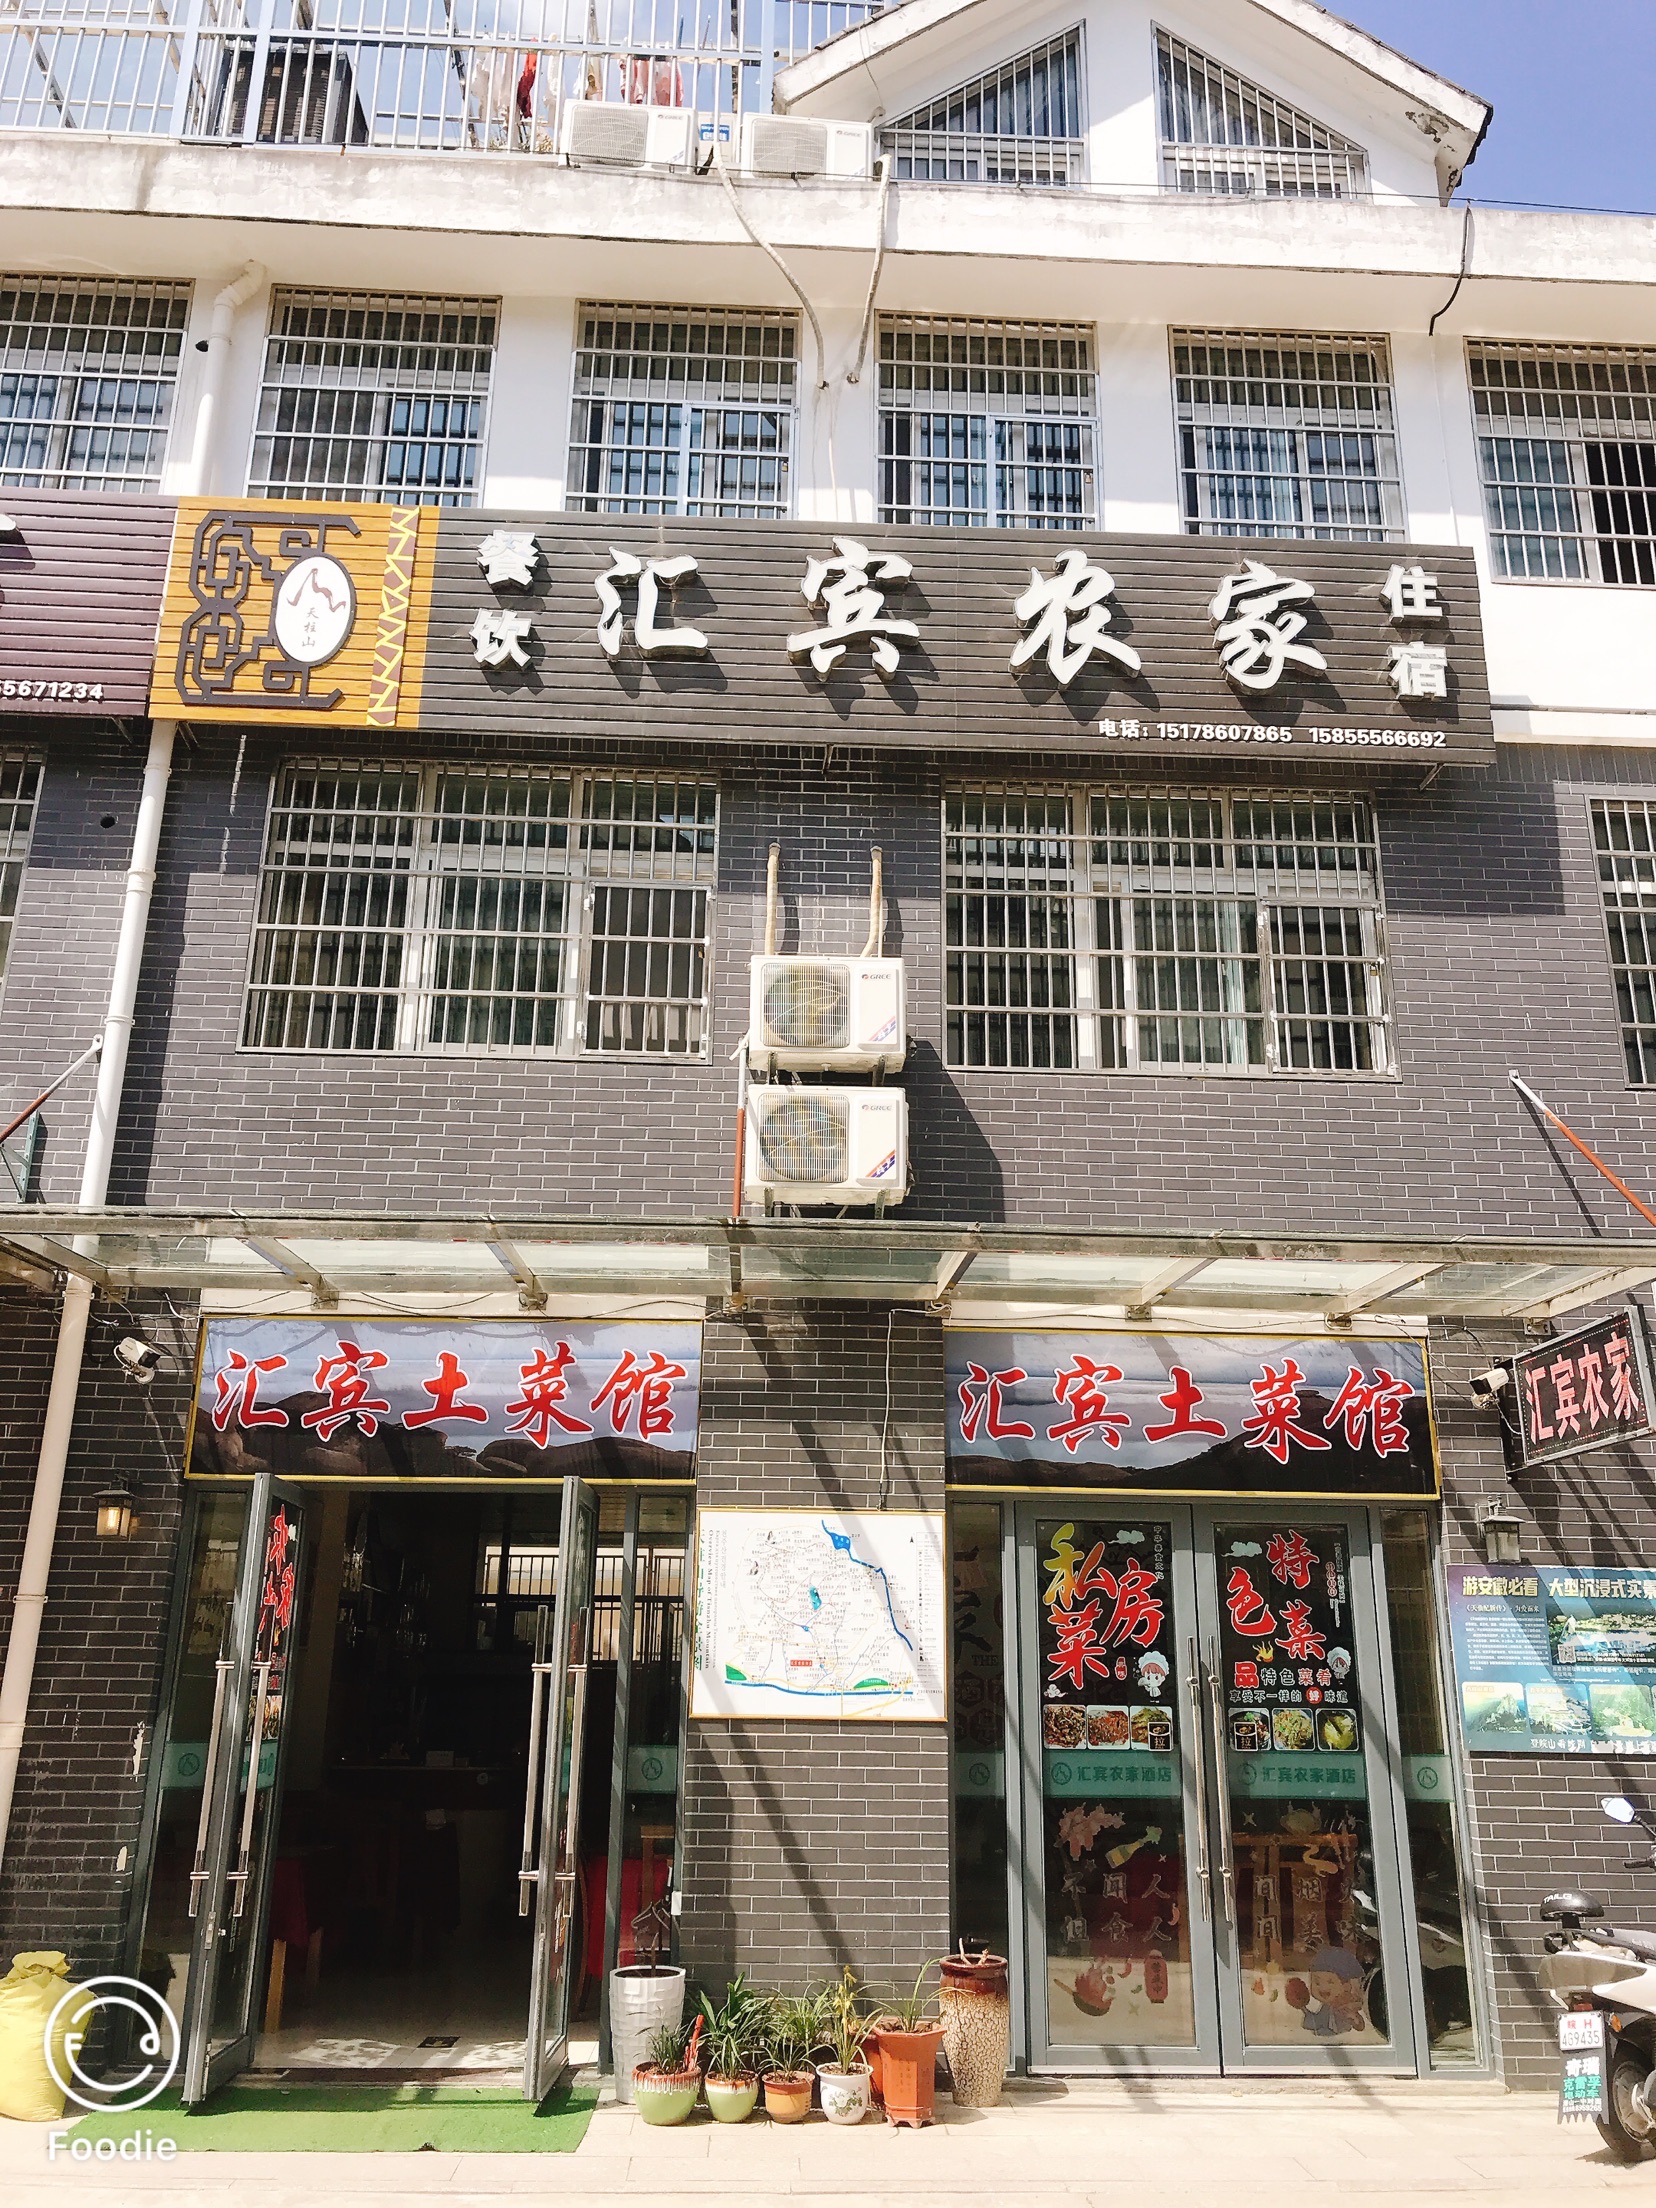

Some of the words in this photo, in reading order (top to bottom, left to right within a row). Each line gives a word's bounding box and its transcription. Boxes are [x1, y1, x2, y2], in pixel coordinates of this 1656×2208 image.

[468, 529, 540, 671] 餐饮
[302, 607, 319, 647] 天柱山
[595, 536, 1328, 693] 汇宾农家
[1382, 563, 1449, 699] 住宿
[0, 680, 103, 699] 5671234
[1156, 722, 1293, 743] 15178607865
[1308, 727, 1447, 747] 15855566692
[211, 1340, 688, 1449] 汇宾土菜馆
[1525, 1332, 1640, 1444] 汇宾农家
[958, 1353, 1415, 1464] 汇宾土菜馆
[707, 1587, 713, 1596] of
[1227, 1529, 1326, 1662] 特色菜
[1463, 1576, 1539, 1597] 游安徽必看
[1043, 1522, 1165, 1690] 私房菜
[1234, 1661, 1332, 1688] 品特色菜肴
[1154, 1737, 1166, 1747] 拉
[1077, 1766, 1172, 1783] 汇宾农家酒店
[1262, 1766, 1356, 1784] 汇宾农家酒店
[1543, 1892, 1573, 1904] TAILG
[1562, 2030, 1600, 2047] 4G9435
